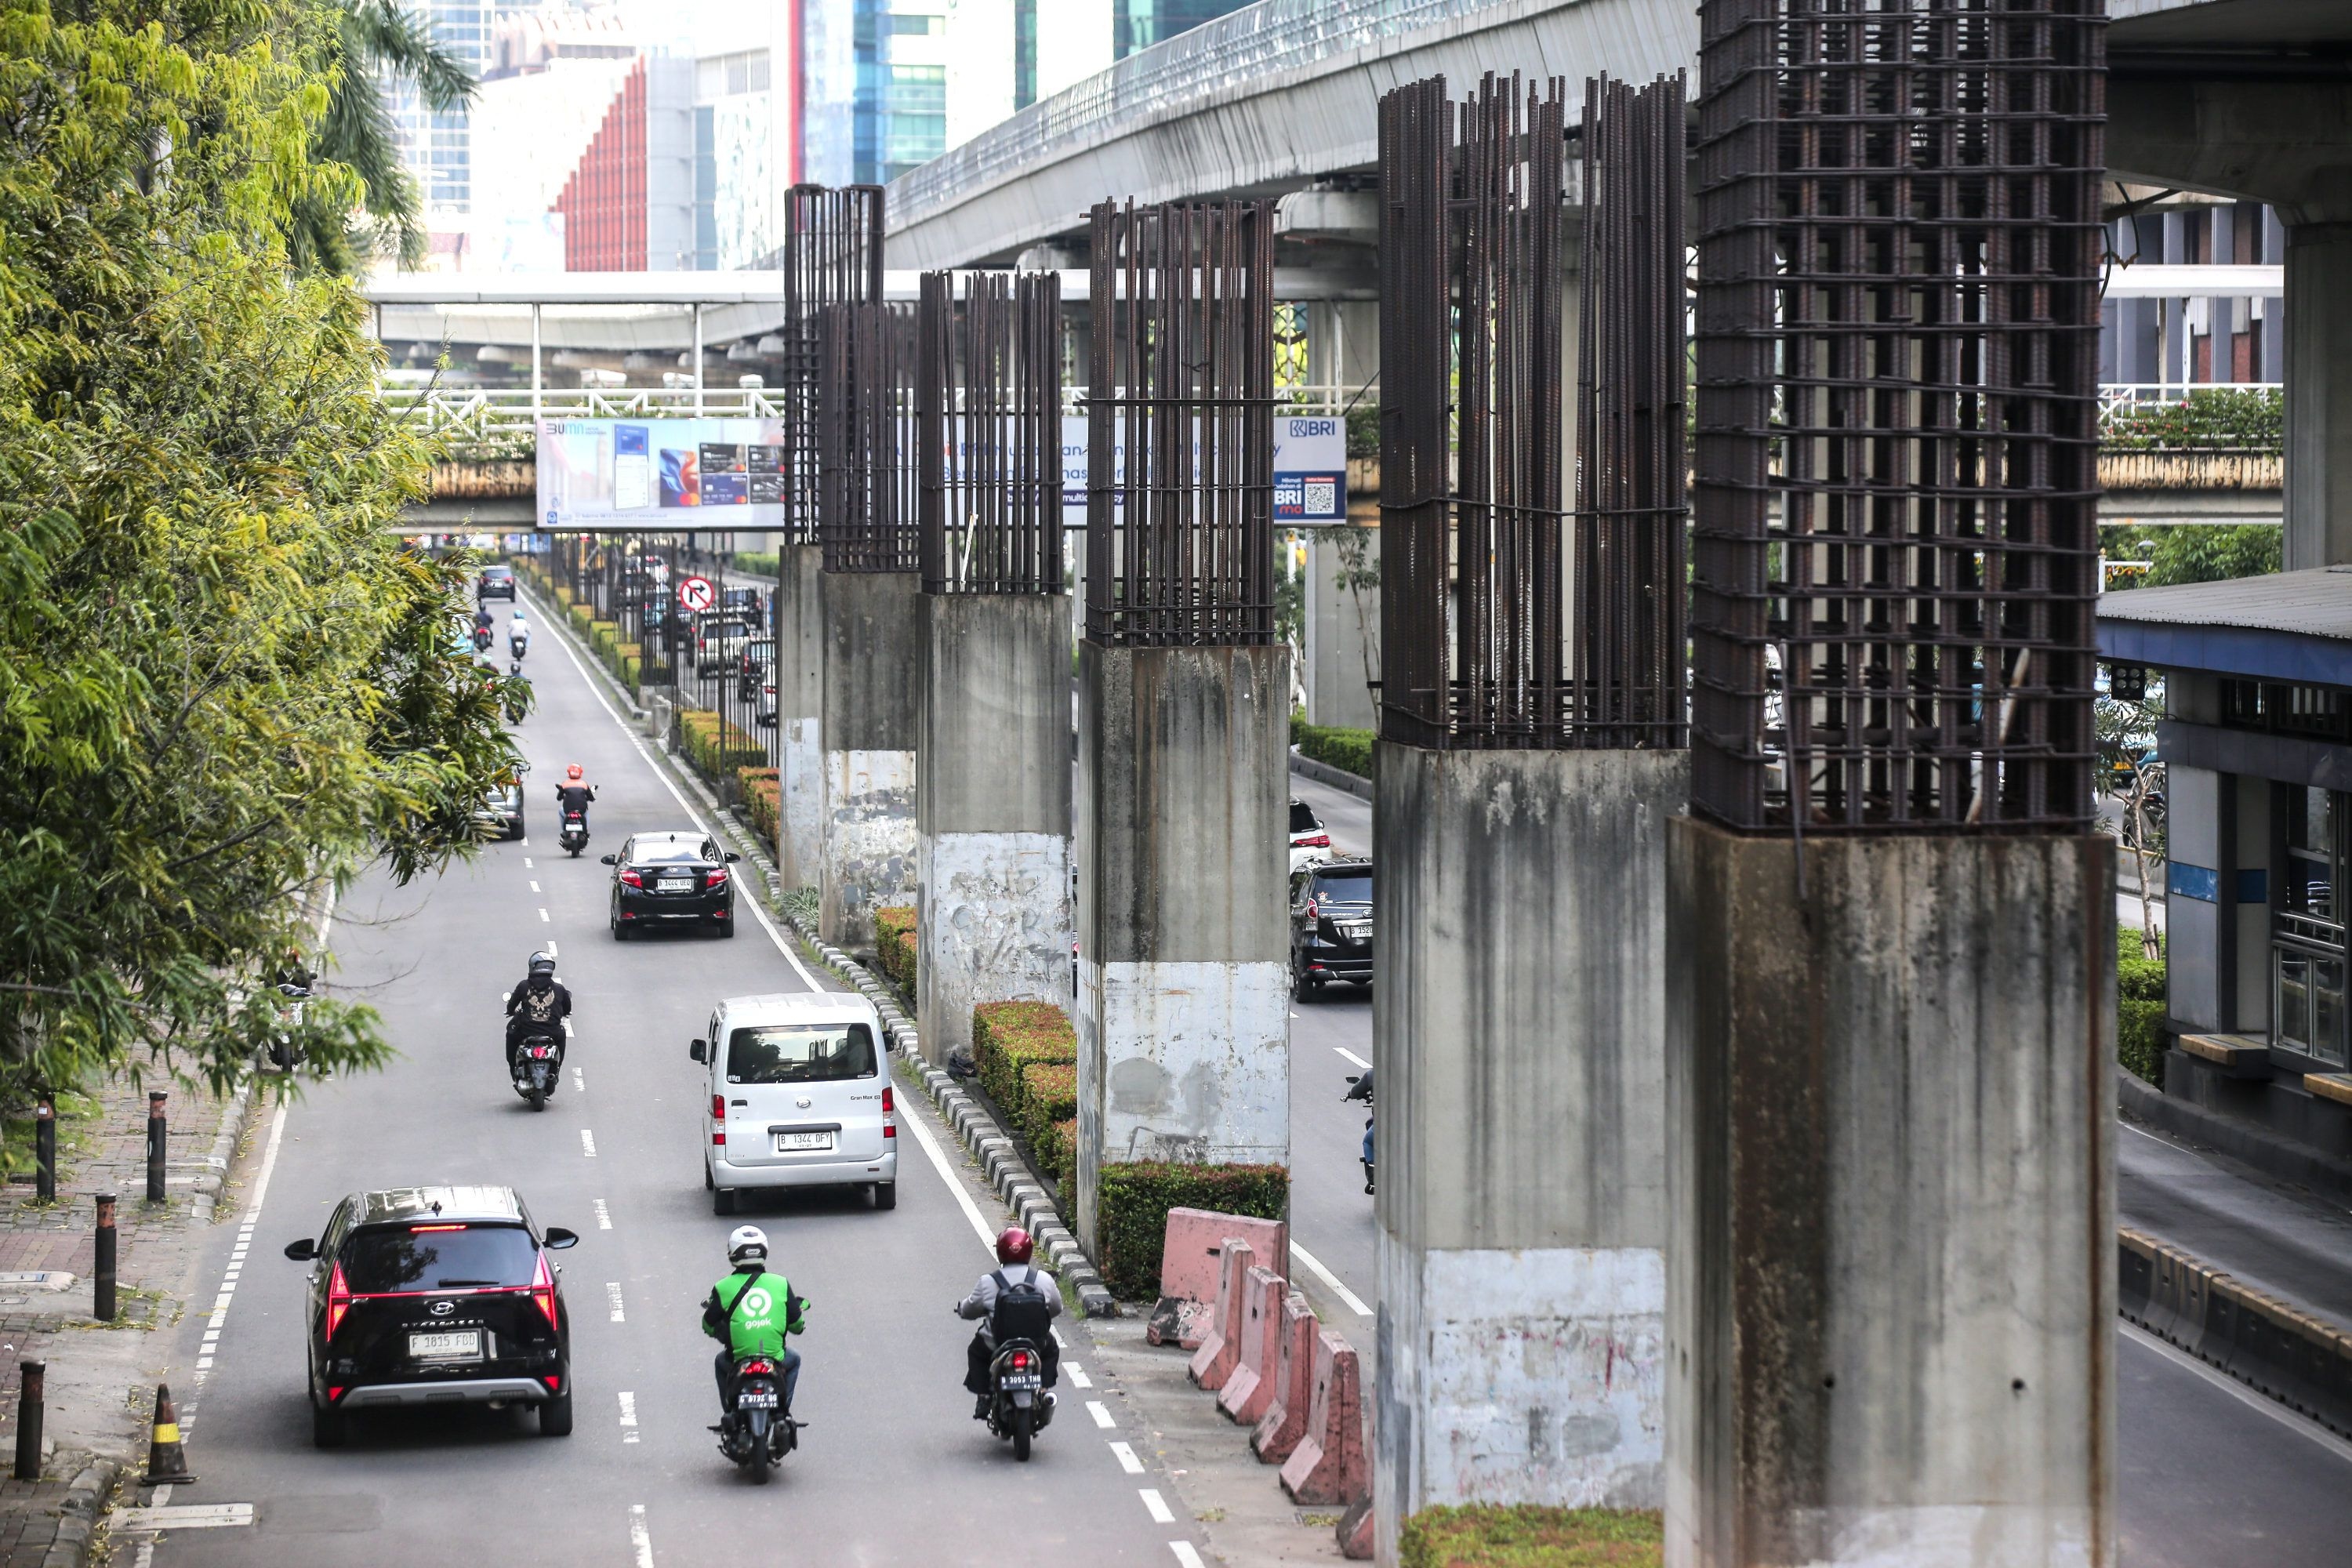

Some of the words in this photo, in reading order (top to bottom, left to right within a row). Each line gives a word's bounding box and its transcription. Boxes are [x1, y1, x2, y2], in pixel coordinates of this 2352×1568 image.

[1308, 420, 1335, 436] BRI
[1273, 490, 1301, 505] BRI
[781, 1134, 786, 1144] B
[794, 1134, 811, 1144] 1344
[745, 1317, 772, 1330] gojek
[412, 1337, 418, 1348] F
[424, 1334, 451, 1347] 1815
